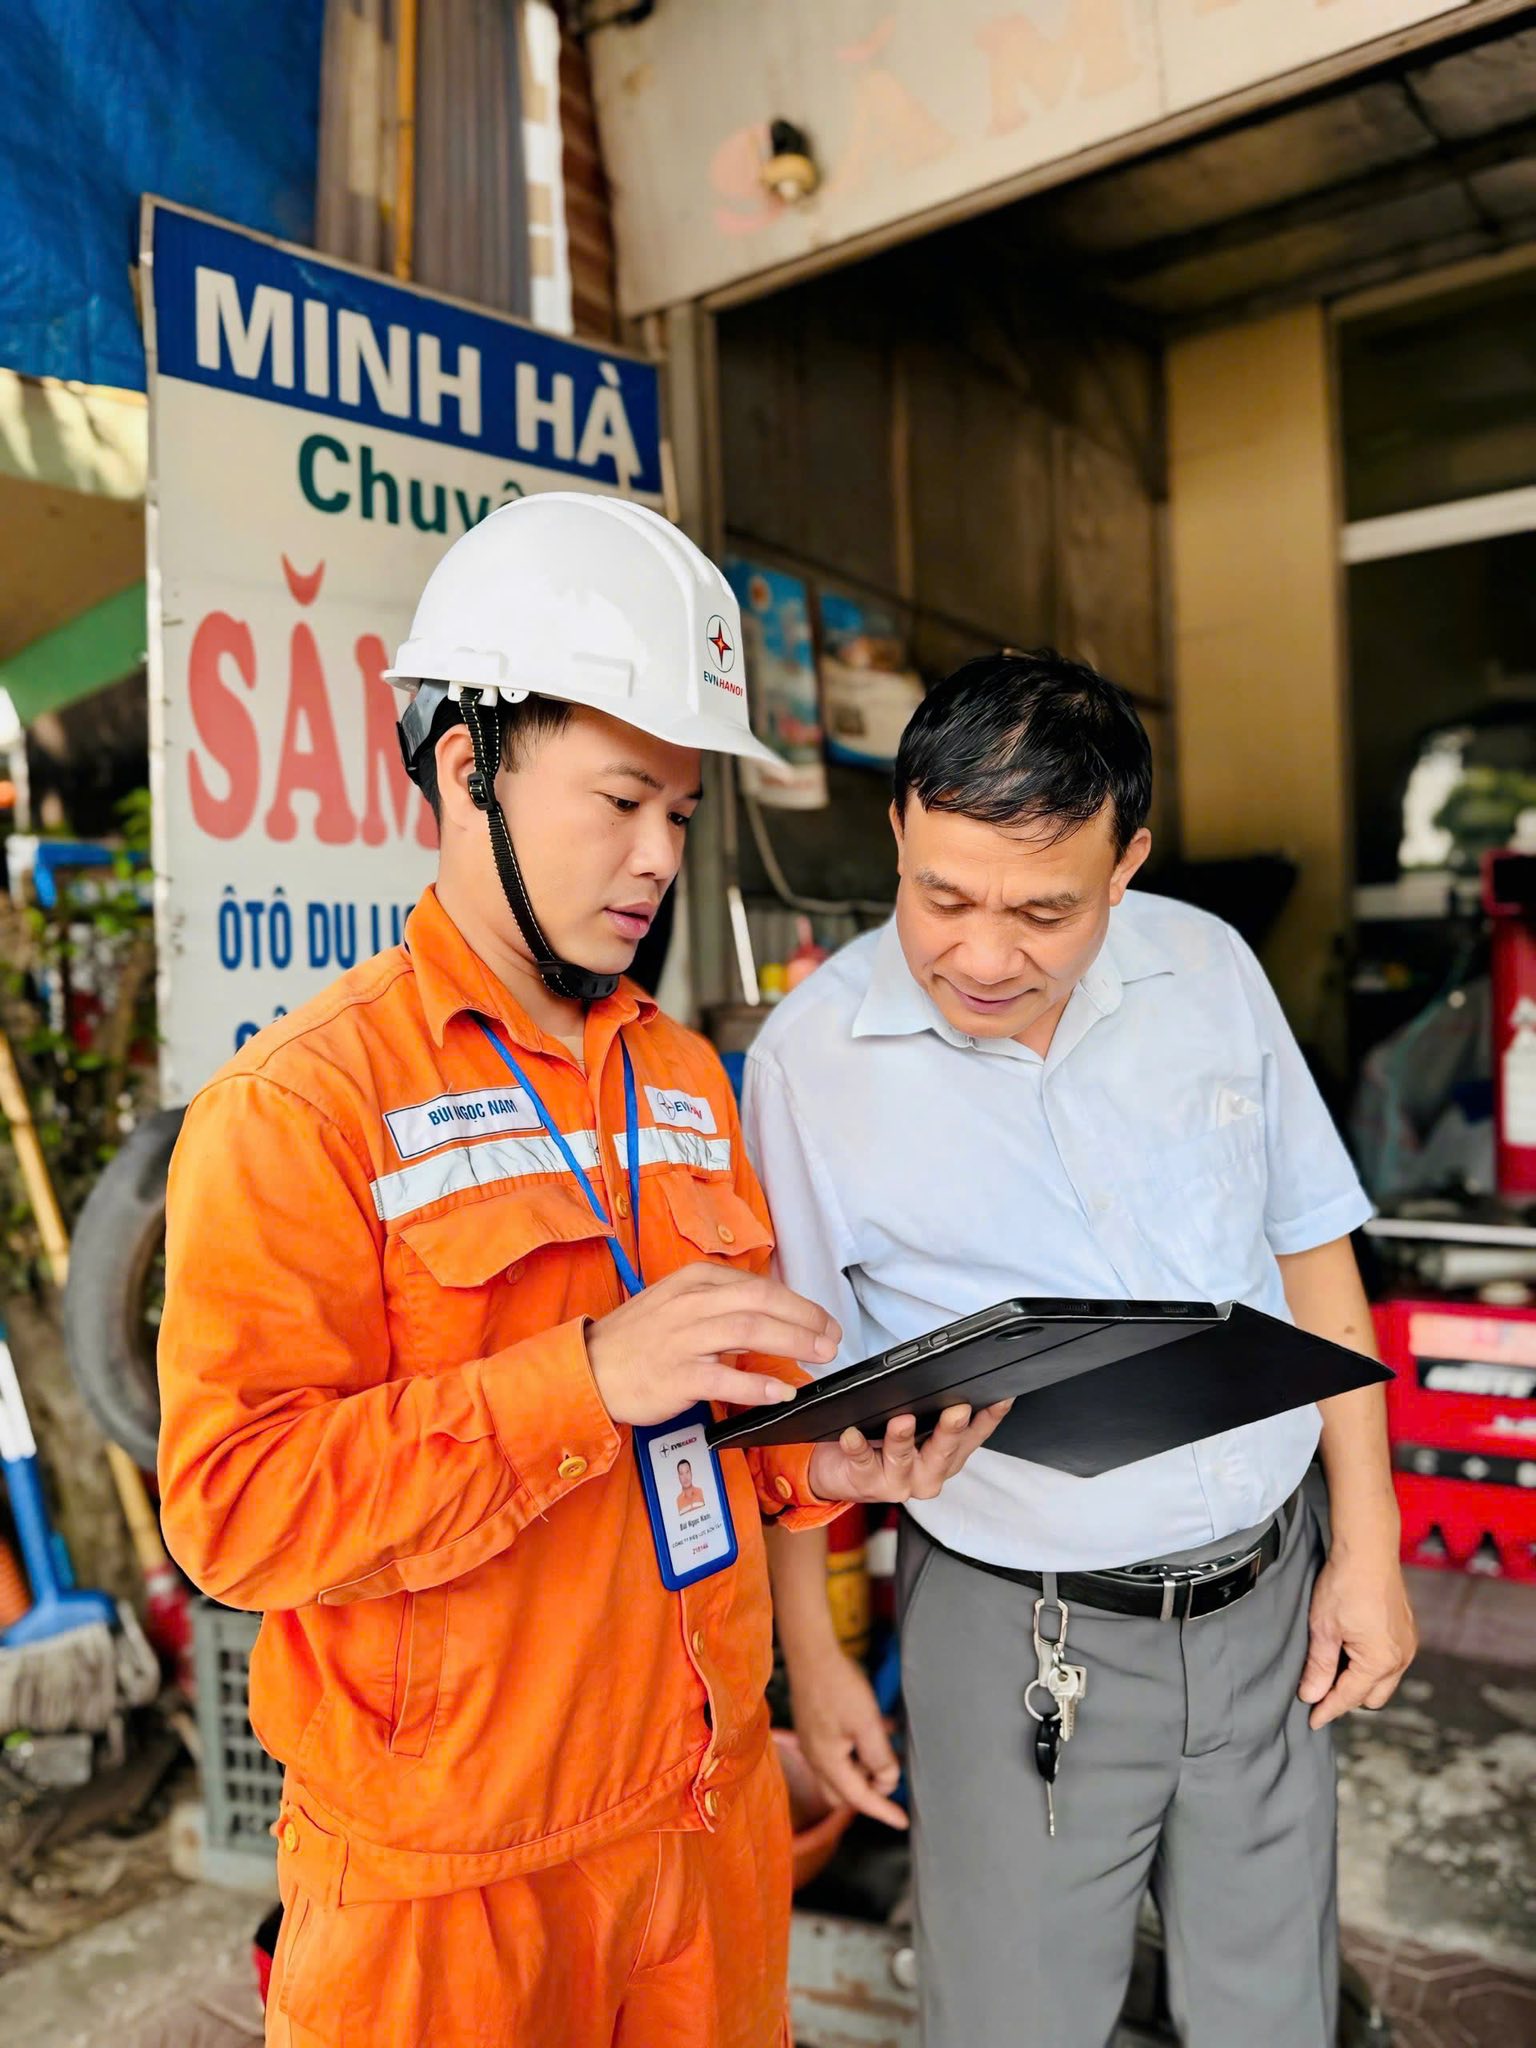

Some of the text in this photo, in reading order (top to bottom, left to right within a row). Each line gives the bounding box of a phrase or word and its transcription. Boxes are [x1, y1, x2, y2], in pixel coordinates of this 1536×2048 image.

[195, 264, 643, 479] MINH HÀ
[296, 432, 526, 534] Chuy
[218, 884, 292, 970] ÔTÔ
[307, 902, 357, 969] DU
[427, 1104, 455, 1126] BÙI
[487, 1099, 518, 1116] NAM
